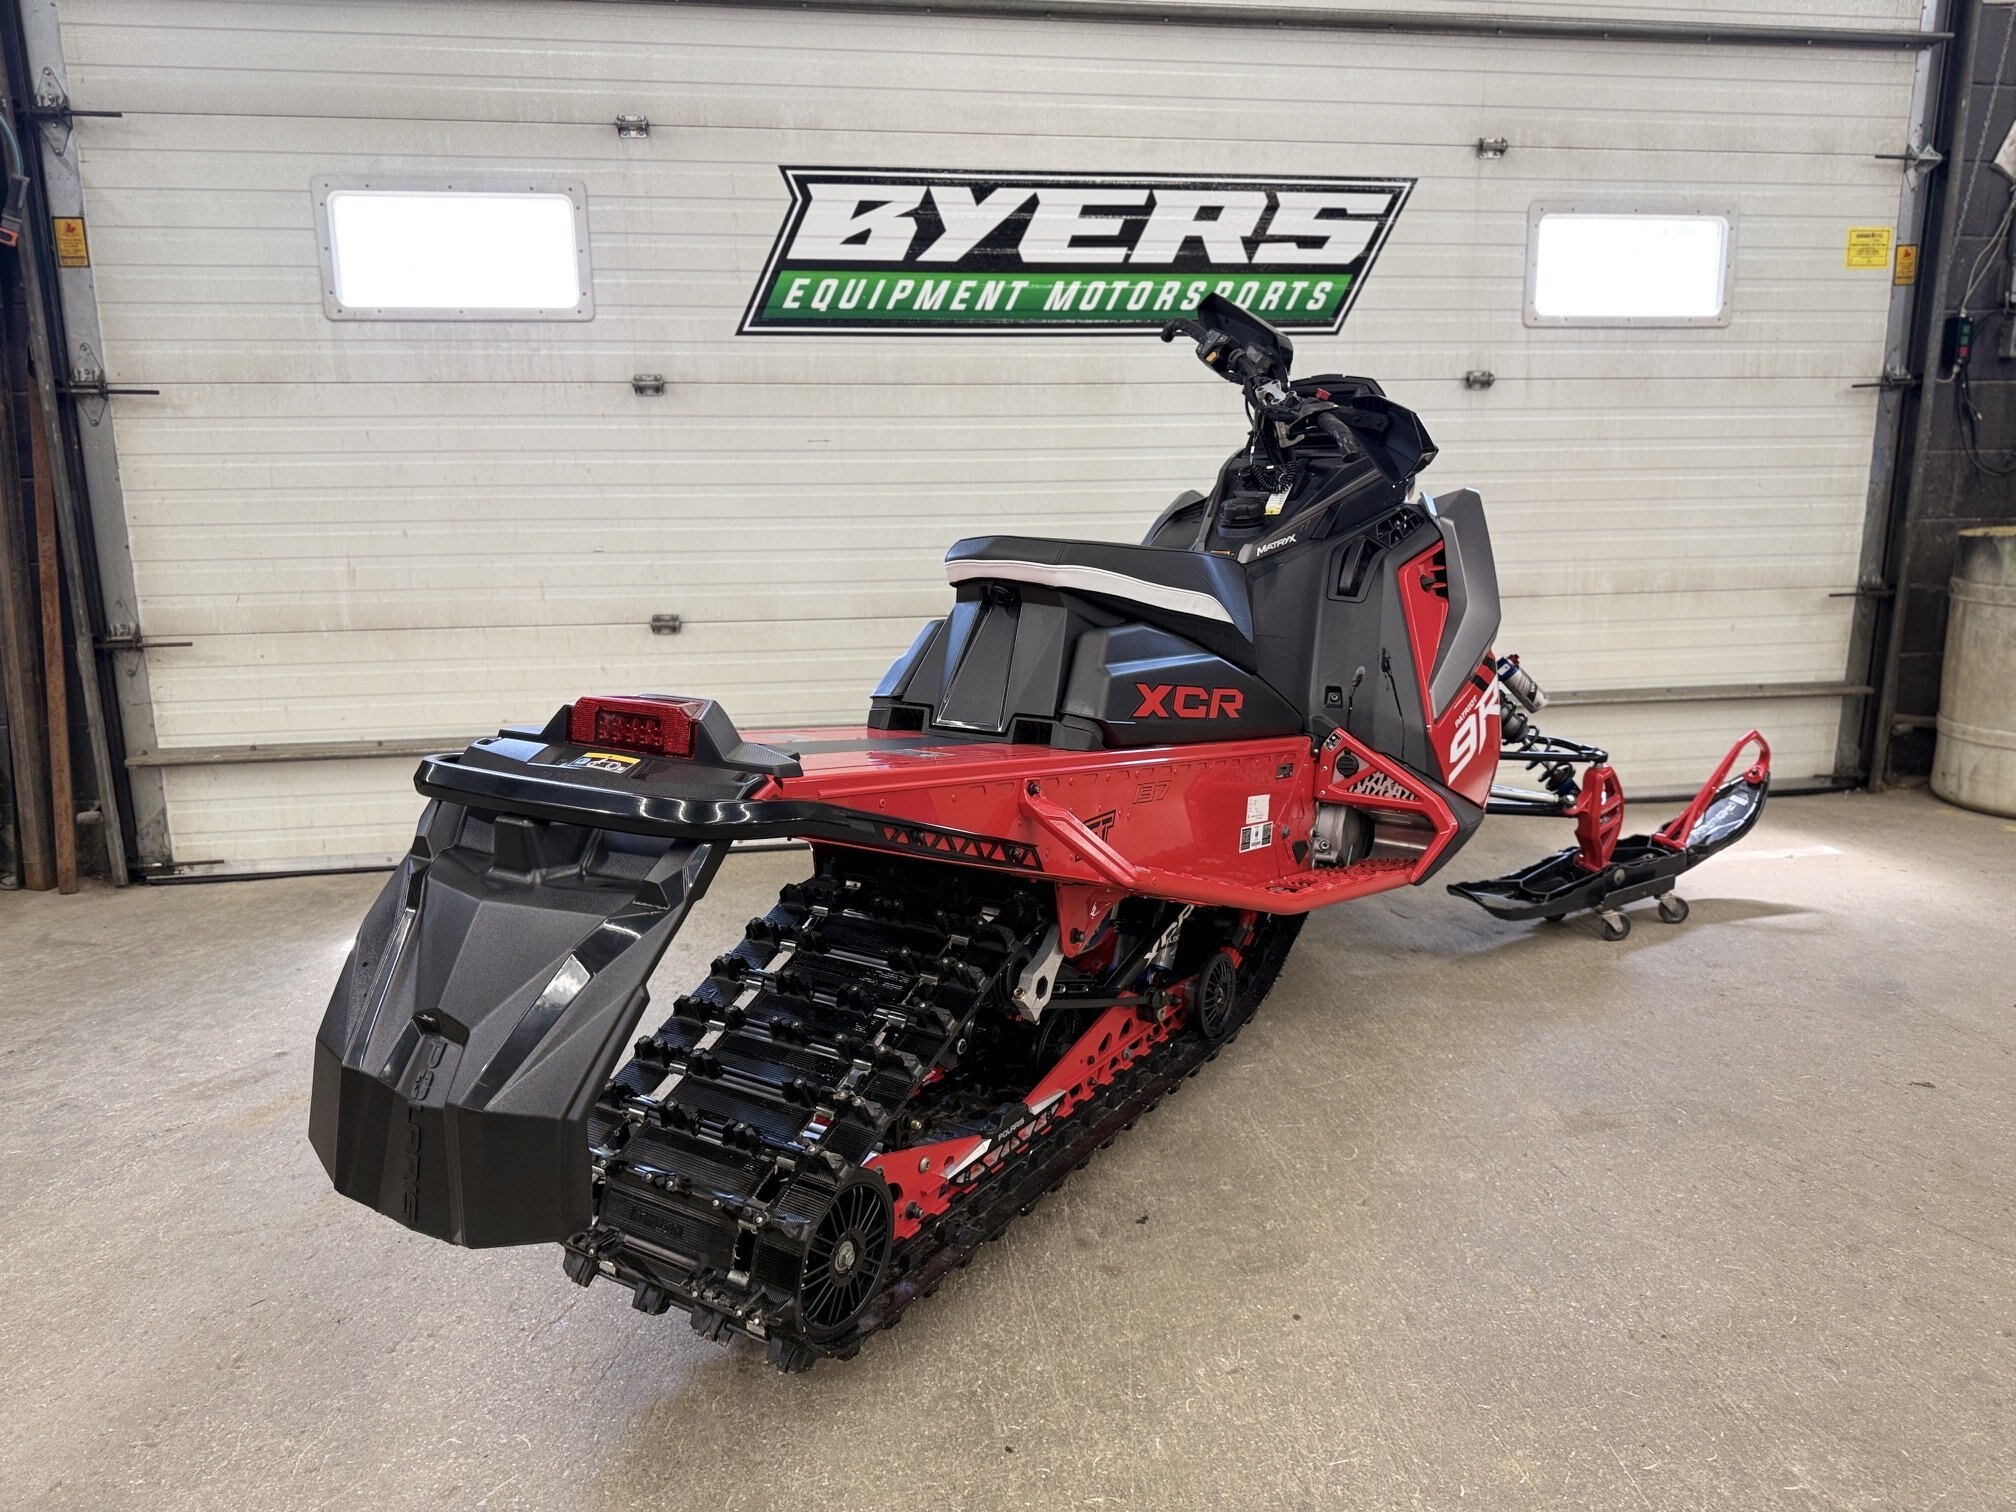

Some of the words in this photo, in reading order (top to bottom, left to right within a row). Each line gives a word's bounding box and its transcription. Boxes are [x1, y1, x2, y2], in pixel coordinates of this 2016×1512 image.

[786, 183, 1389, 264] BYERS
[782, 278, 1029, 311] EQUIPMENT
[1043, 281, 1334, 311] MOTORSPORTS
[1256, 533, 1297, 557] MATRYX
[1131, 682, 1245, 720] XCR
[1454, 694, 1478, 729] PATRIOT
[1447, 672, 1501, 787] 9R
[1131, 779, 1172, 805] 137
[401, 1038, 450, 1225] POLARIS
[997, 1116, 1025, 1141] POLARIS
